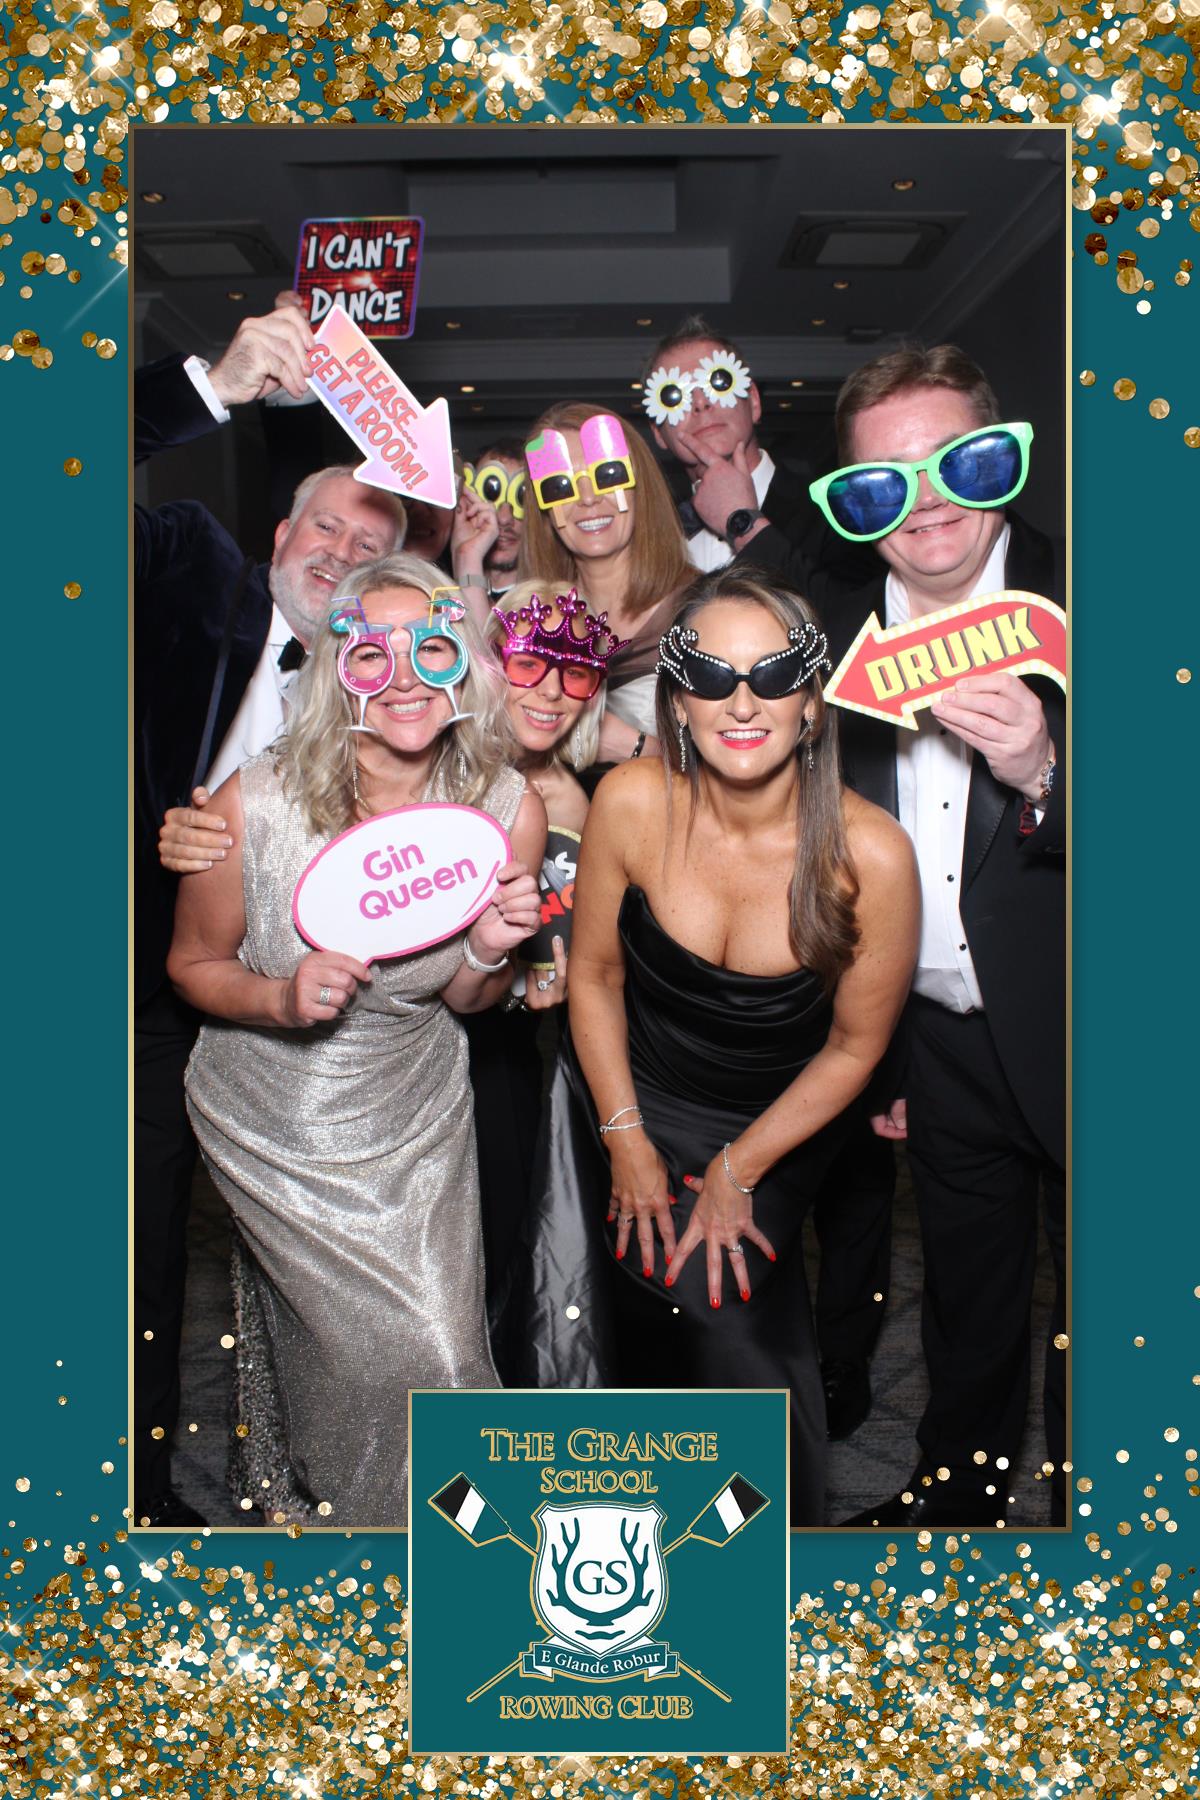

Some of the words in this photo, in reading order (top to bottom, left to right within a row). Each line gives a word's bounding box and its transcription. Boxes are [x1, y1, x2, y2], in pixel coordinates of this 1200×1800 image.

[305, 234, 319, 269] I
[323, 231, 412, 270] CAN'T
[306, 343, 351, 392] GET
[339, 392, 366, 415] A
[354, 411, 429, 491] ROOM!
[346, 347, 418, 450] PLEASE...
[864, 607, 1042, 701] DRUNK
[359, 858, 478, 920] Queen
[363, 844, 425, 881] Gin
